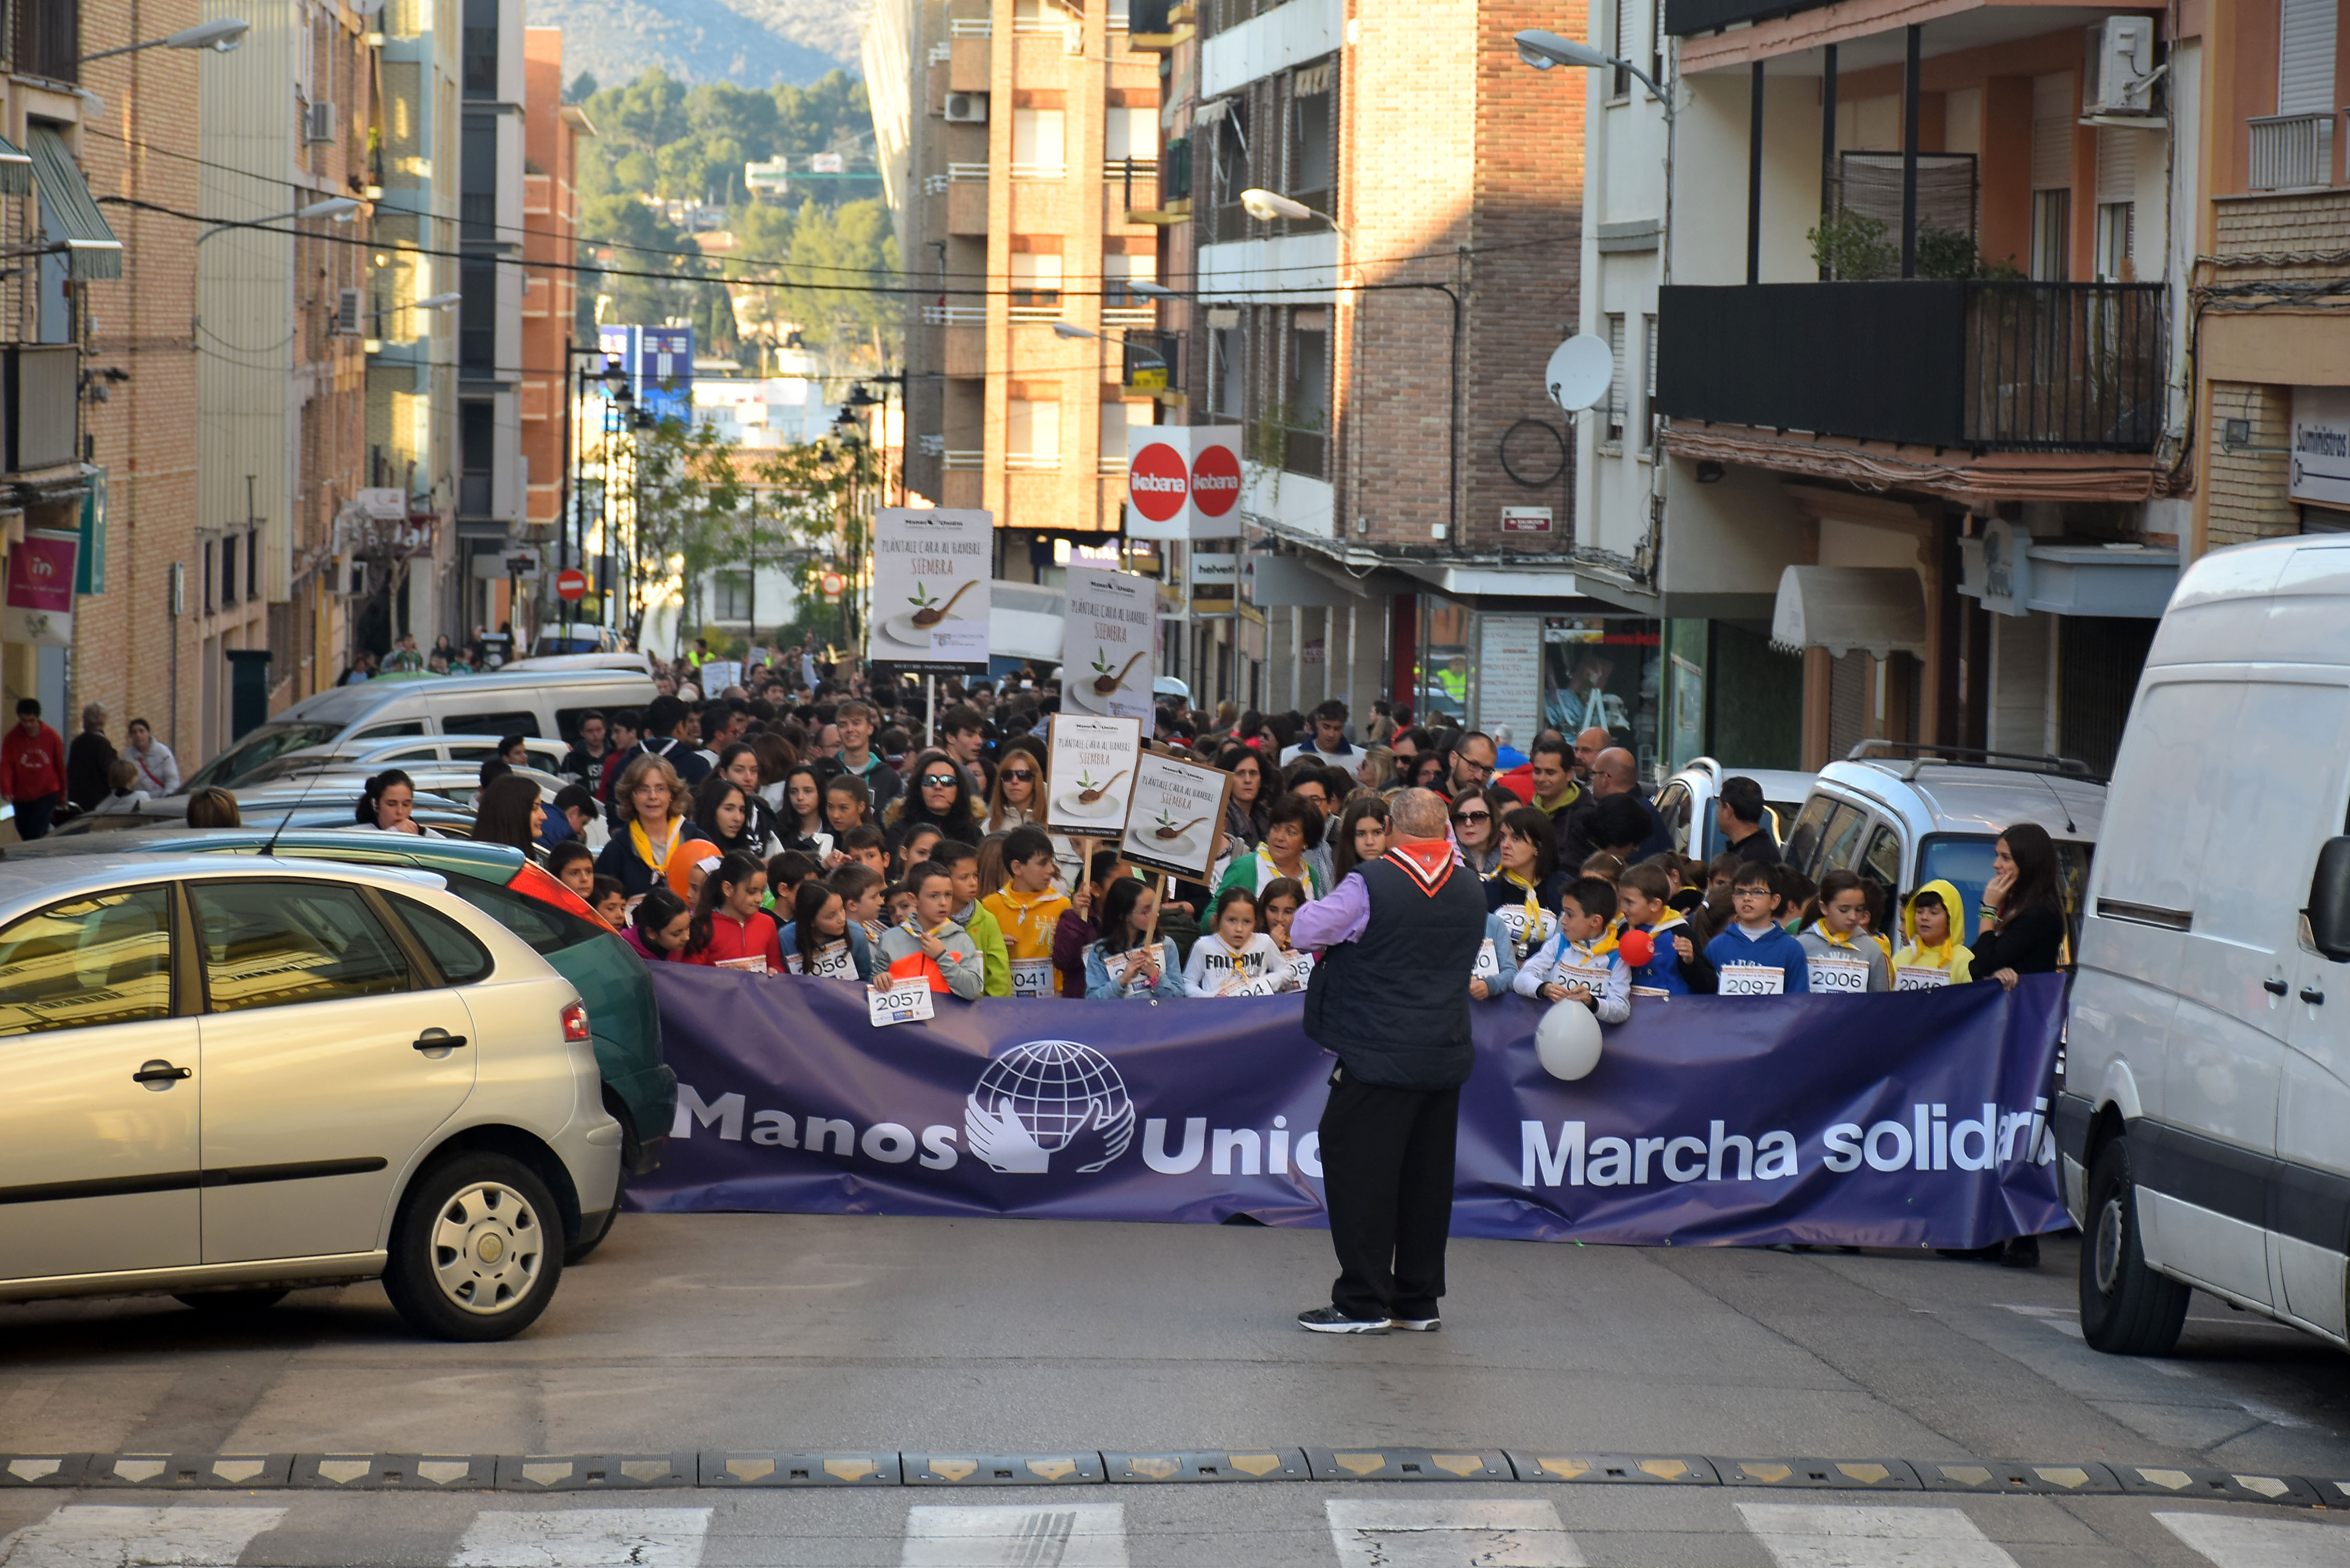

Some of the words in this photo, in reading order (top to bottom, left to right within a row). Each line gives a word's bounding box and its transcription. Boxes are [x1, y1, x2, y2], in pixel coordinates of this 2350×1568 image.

[2297, 422, 2346, 457] Suministros
[1131, 471, 1185, 493] ikebana
[1193, 472, 1238, 490] ikebana
[919, 540, 939, 554] CARA
[942, 541, 950, 554] AL
[911, 559, 953, 575] SIEMBRA
[1101, 605, 1116, 619] CARA
[1118, 608, 1124, 621] AL
[1095, 622, 1127, 643] SIEMBRA
[1086, 740, 1100, 750] CARA
[1102, 741, 1108, 751] AL
[1079, 752, 1110, 766] SIEMBRA
[1169, 783, 1183, 794] CARA
[1185, 787, 1191, 797] AL
[1161, 792, 1192, 810] SIEMBRA
[1726, 979, 1777, 995] 2097
[1812, 971, 1861, 988] 2006
[876, 991, 924, 1011] 2057
[670, 1082, 958, 1170] Manos
[1520, 1120, 1798, 1187] Marcha
